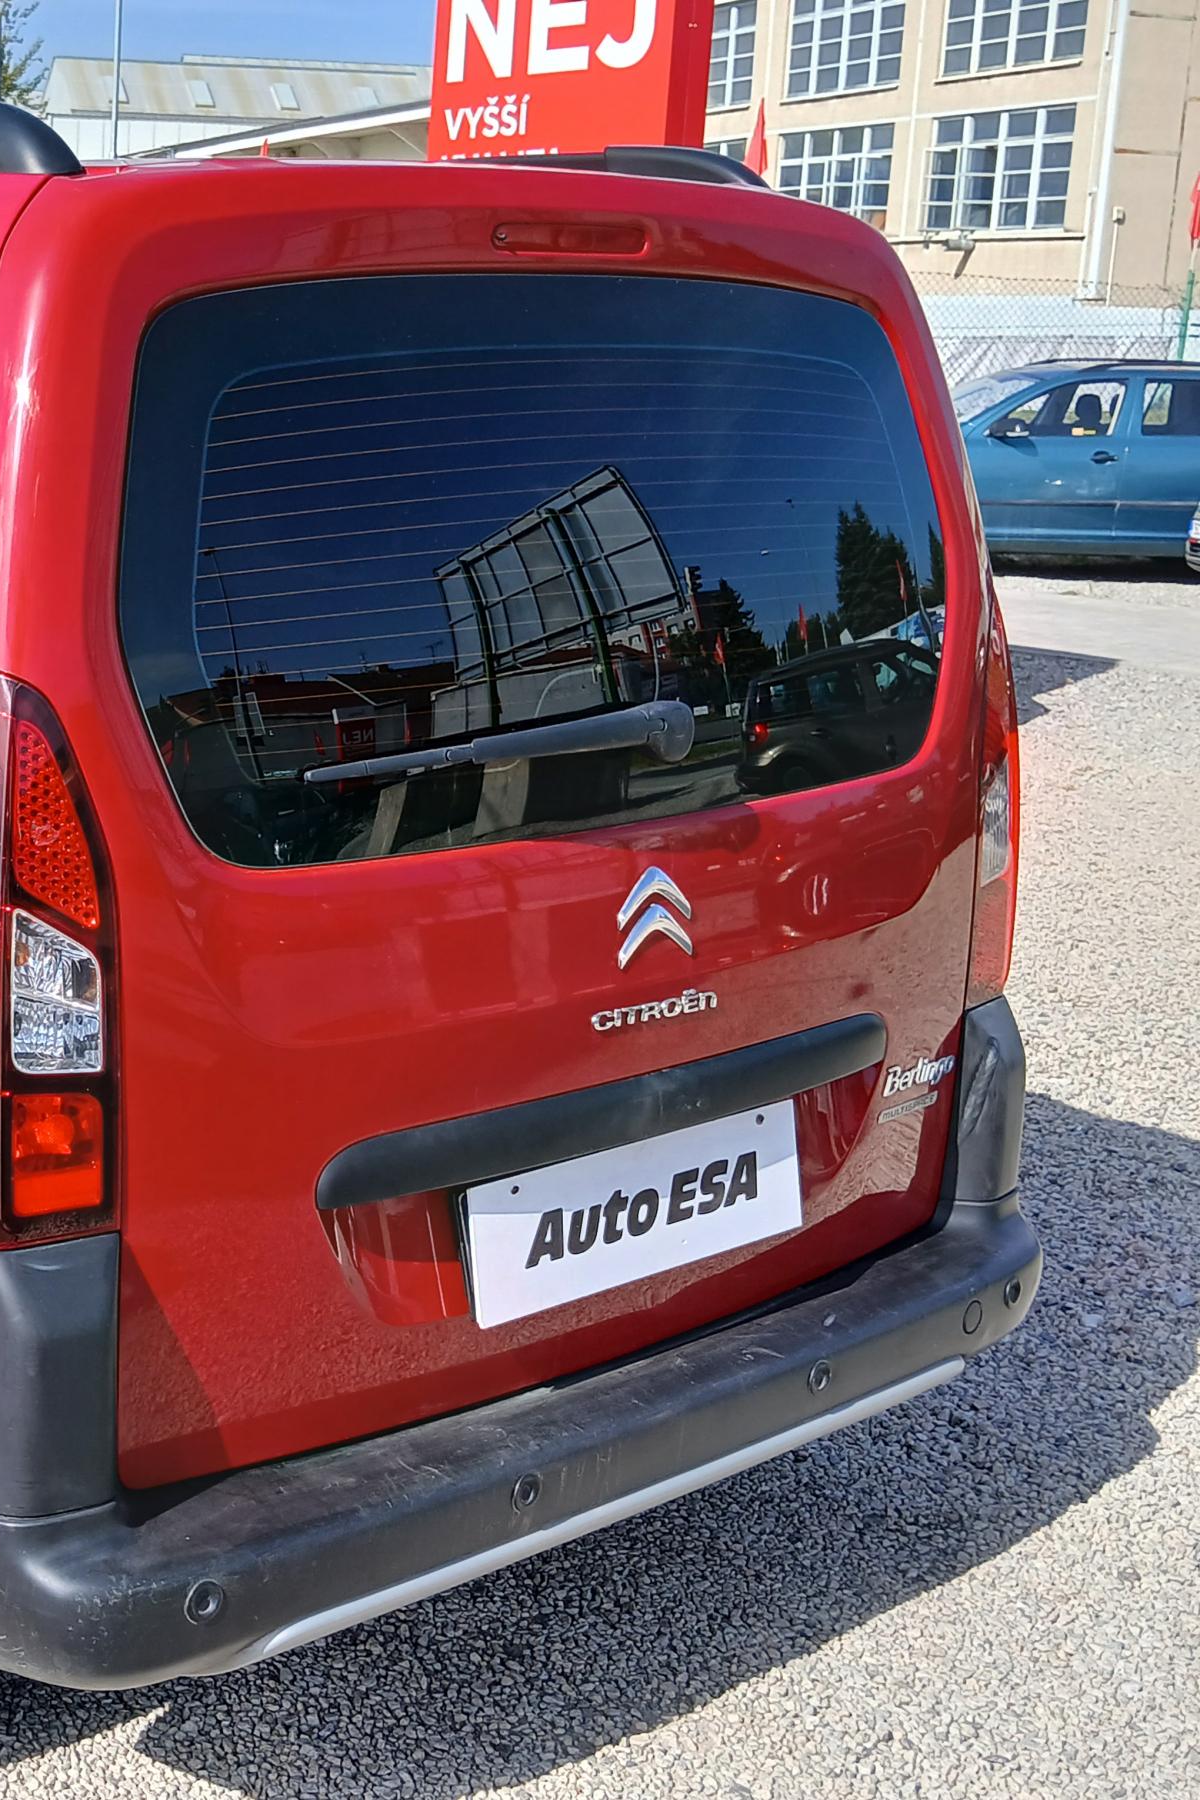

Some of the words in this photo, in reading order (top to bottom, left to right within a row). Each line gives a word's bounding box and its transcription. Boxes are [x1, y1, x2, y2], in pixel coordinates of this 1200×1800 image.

[446, 0, 657, 84] NEJ
[444, 93, 531, 141] VYŠŠÍ
[882, 1055, 955, 1097] Berlingo
[525, 1188, 660, 1269] Auto
[666, 1150, 758, 1226] ESA
